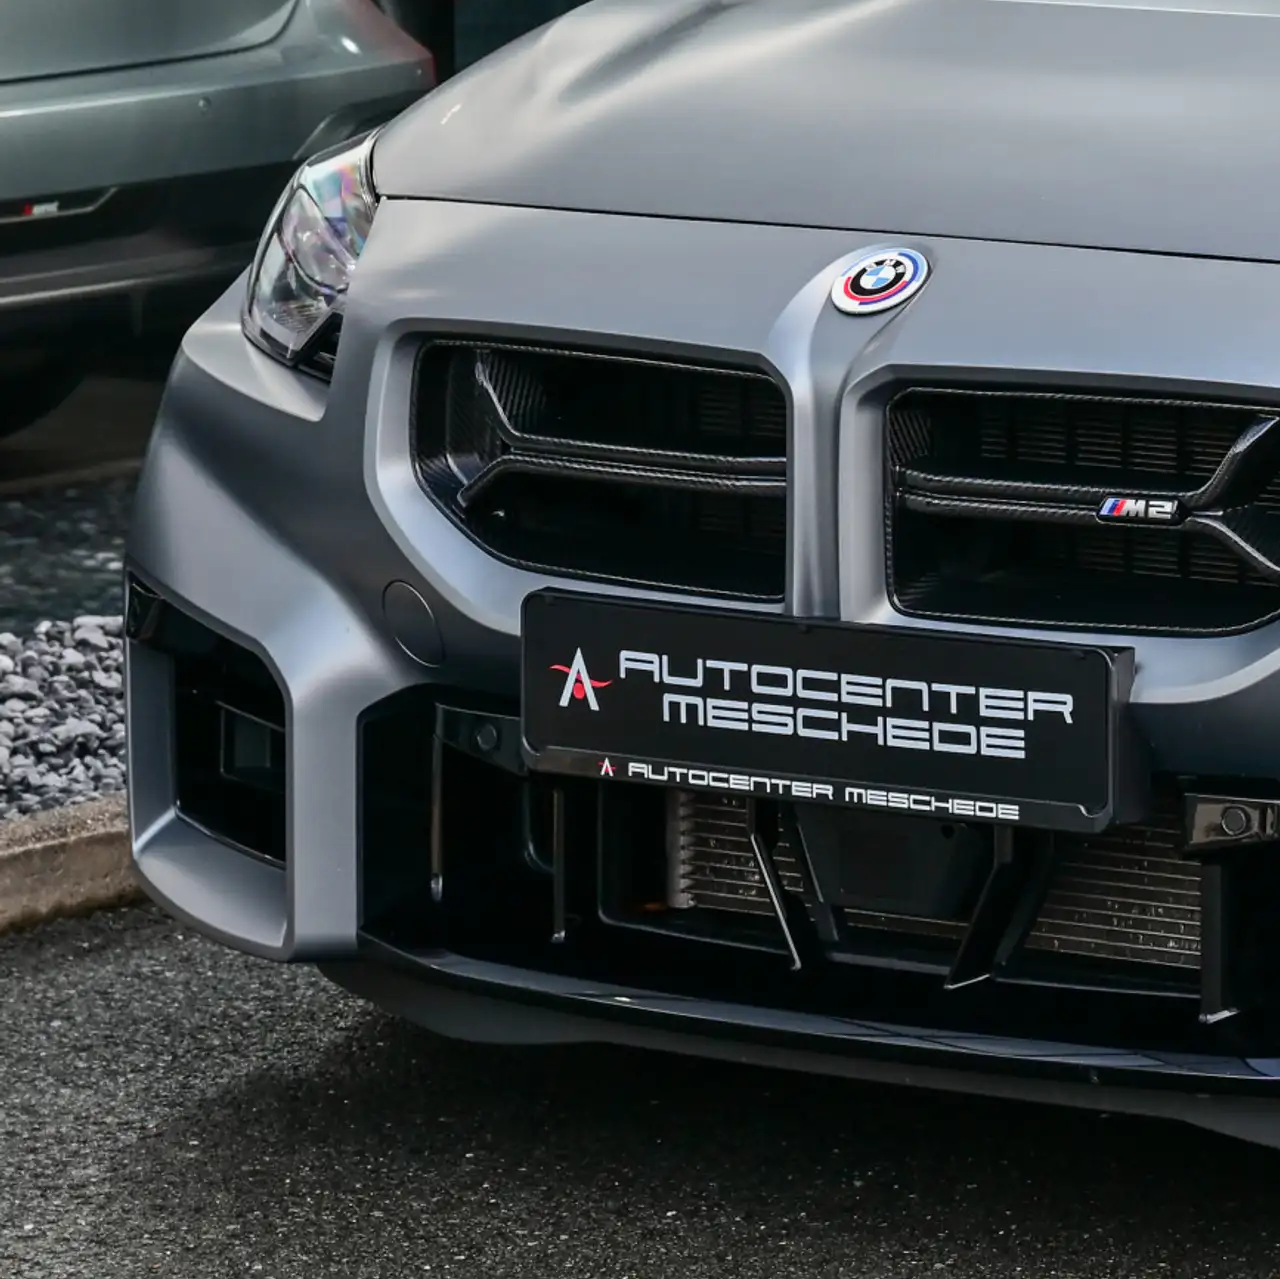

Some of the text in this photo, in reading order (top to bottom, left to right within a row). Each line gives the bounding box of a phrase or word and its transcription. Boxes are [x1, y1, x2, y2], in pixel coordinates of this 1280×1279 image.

[1121, 499, 1172, 519] M2
[619, 650, 1073, 723] AUTOCENTER
[663, 693, 1025, 758] MESCHEDE
[628, 762, 833, 800] AUTOCENTER
[845, 787, 1019, 820] MESCHEDE
